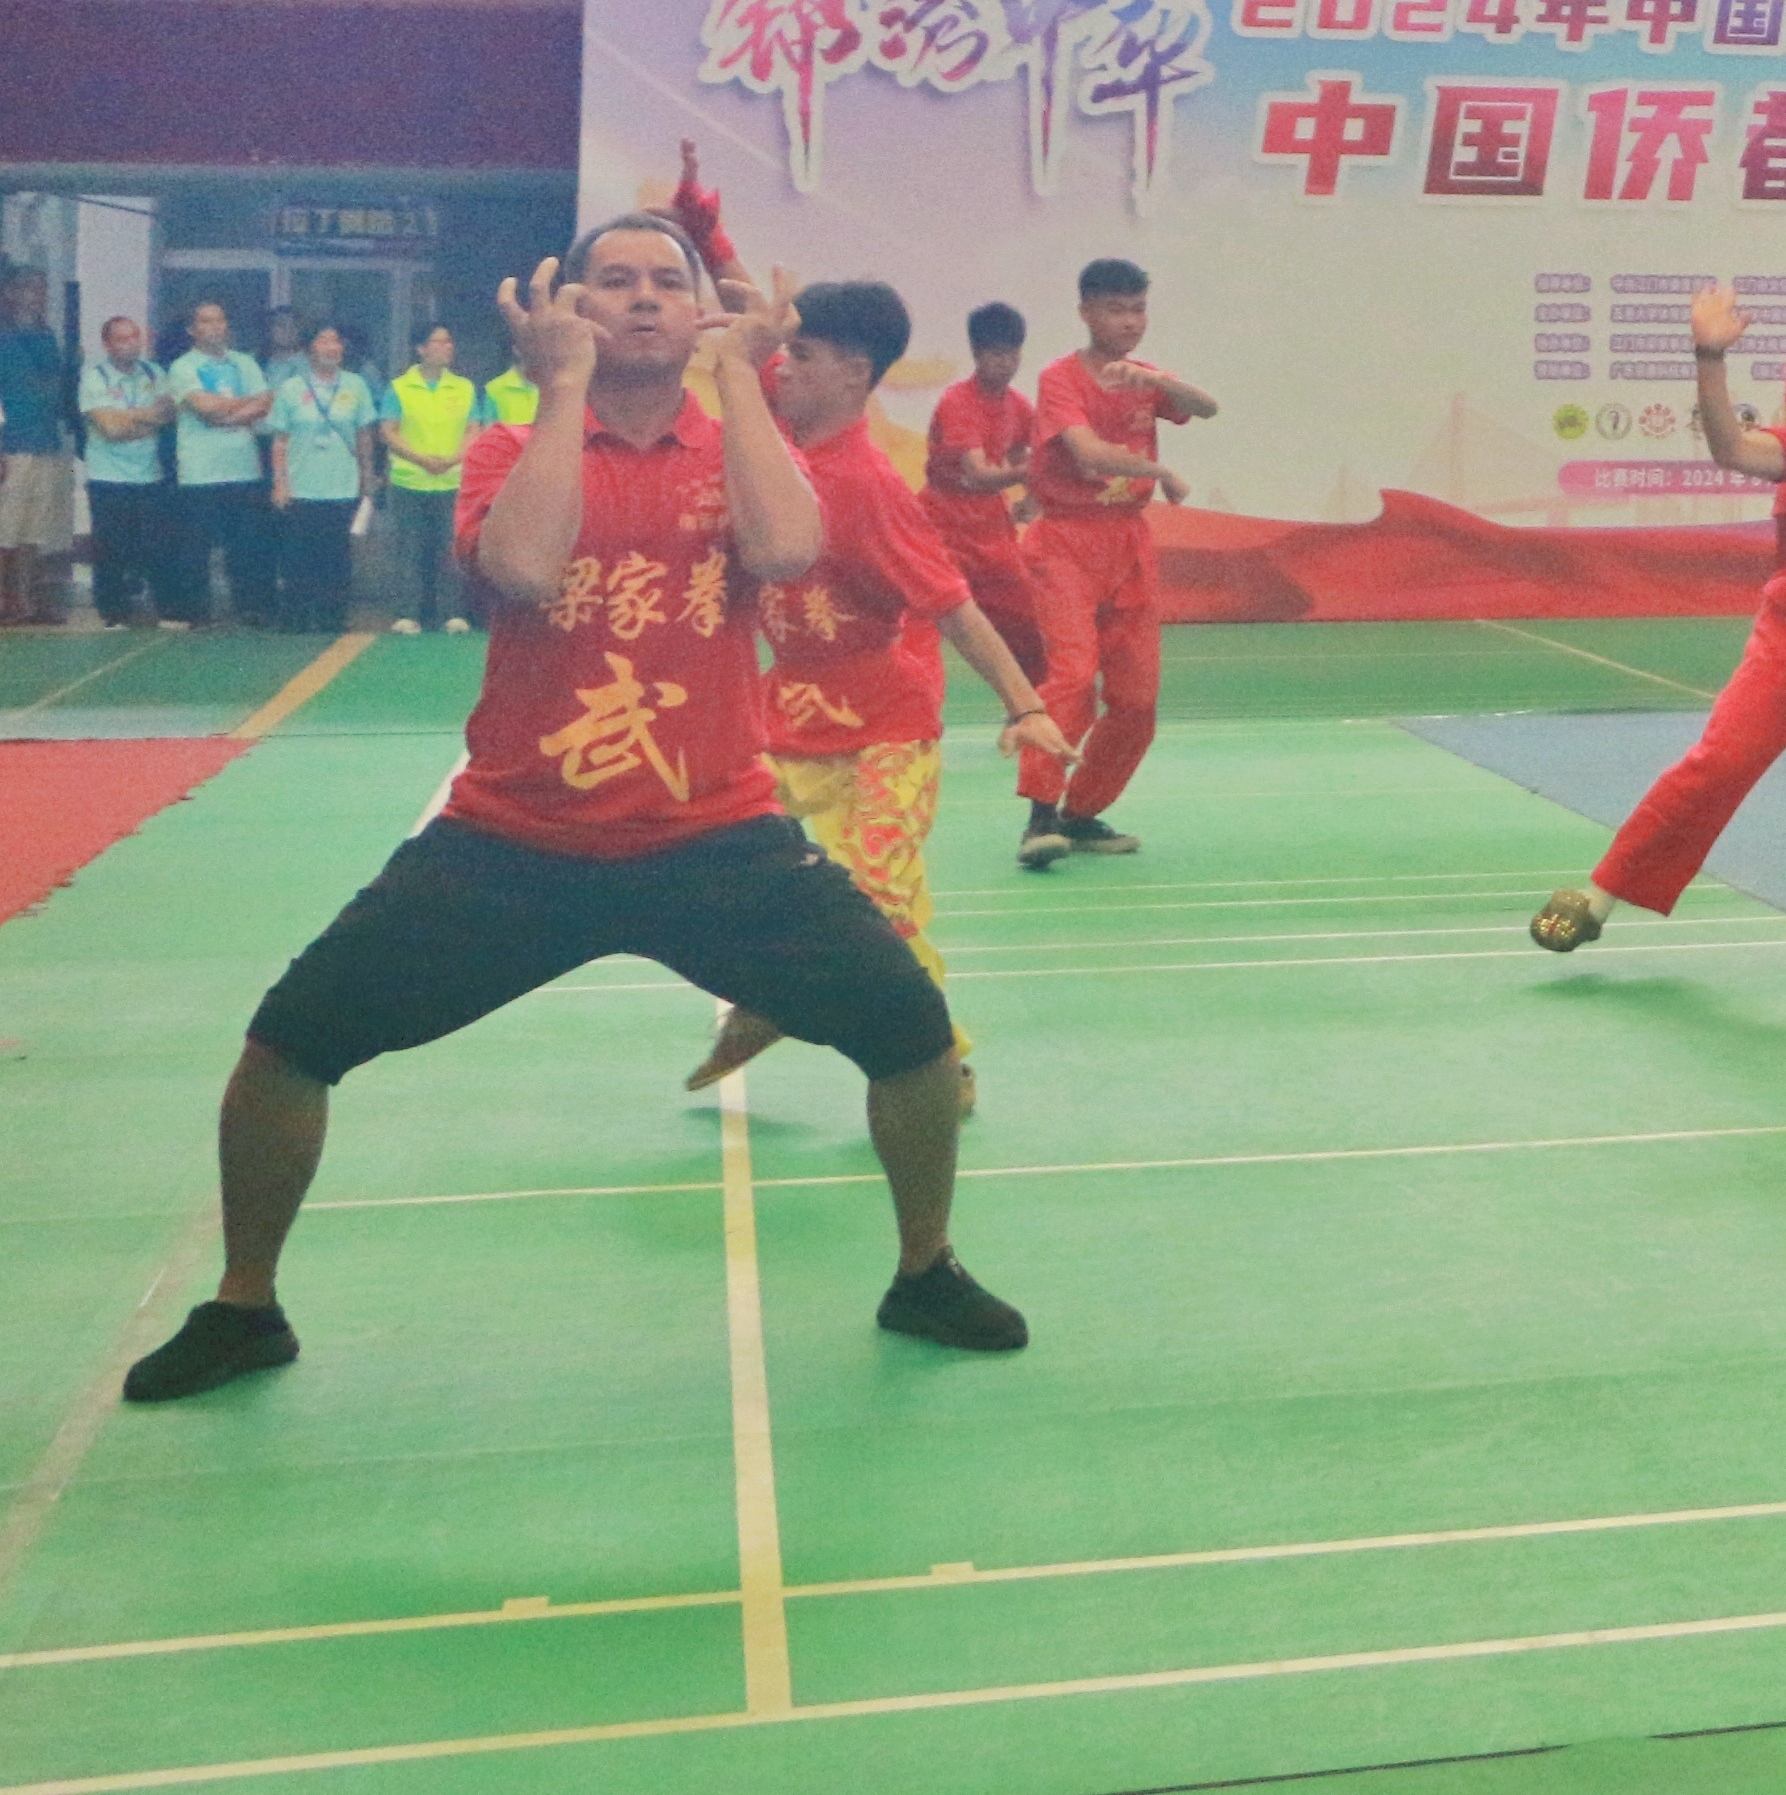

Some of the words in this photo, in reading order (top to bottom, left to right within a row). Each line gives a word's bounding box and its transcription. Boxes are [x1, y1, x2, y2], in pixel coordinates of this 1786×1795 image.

[541, 546, 729, 640] 梁家拳
[540, 651, 690, 803] 武
